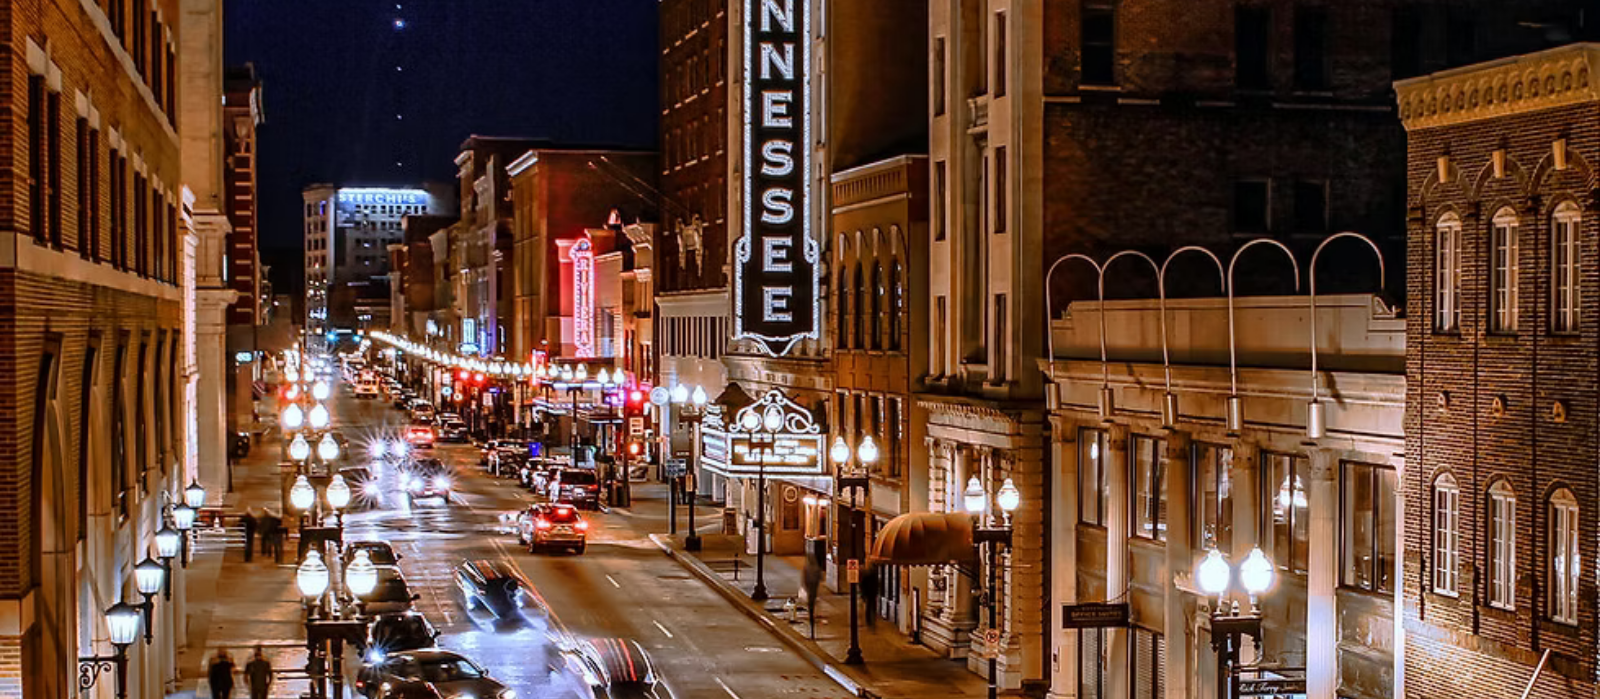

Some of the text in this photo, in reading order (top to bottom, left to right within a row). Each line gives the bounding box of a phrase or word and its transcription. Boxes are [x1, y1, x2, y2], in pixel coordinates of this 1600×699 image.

[339, 193, 416, 203] STERCHI'S
[760, 0, 795, 322] NNESSEE
[579, 258, 590, 344] RIVIERA
